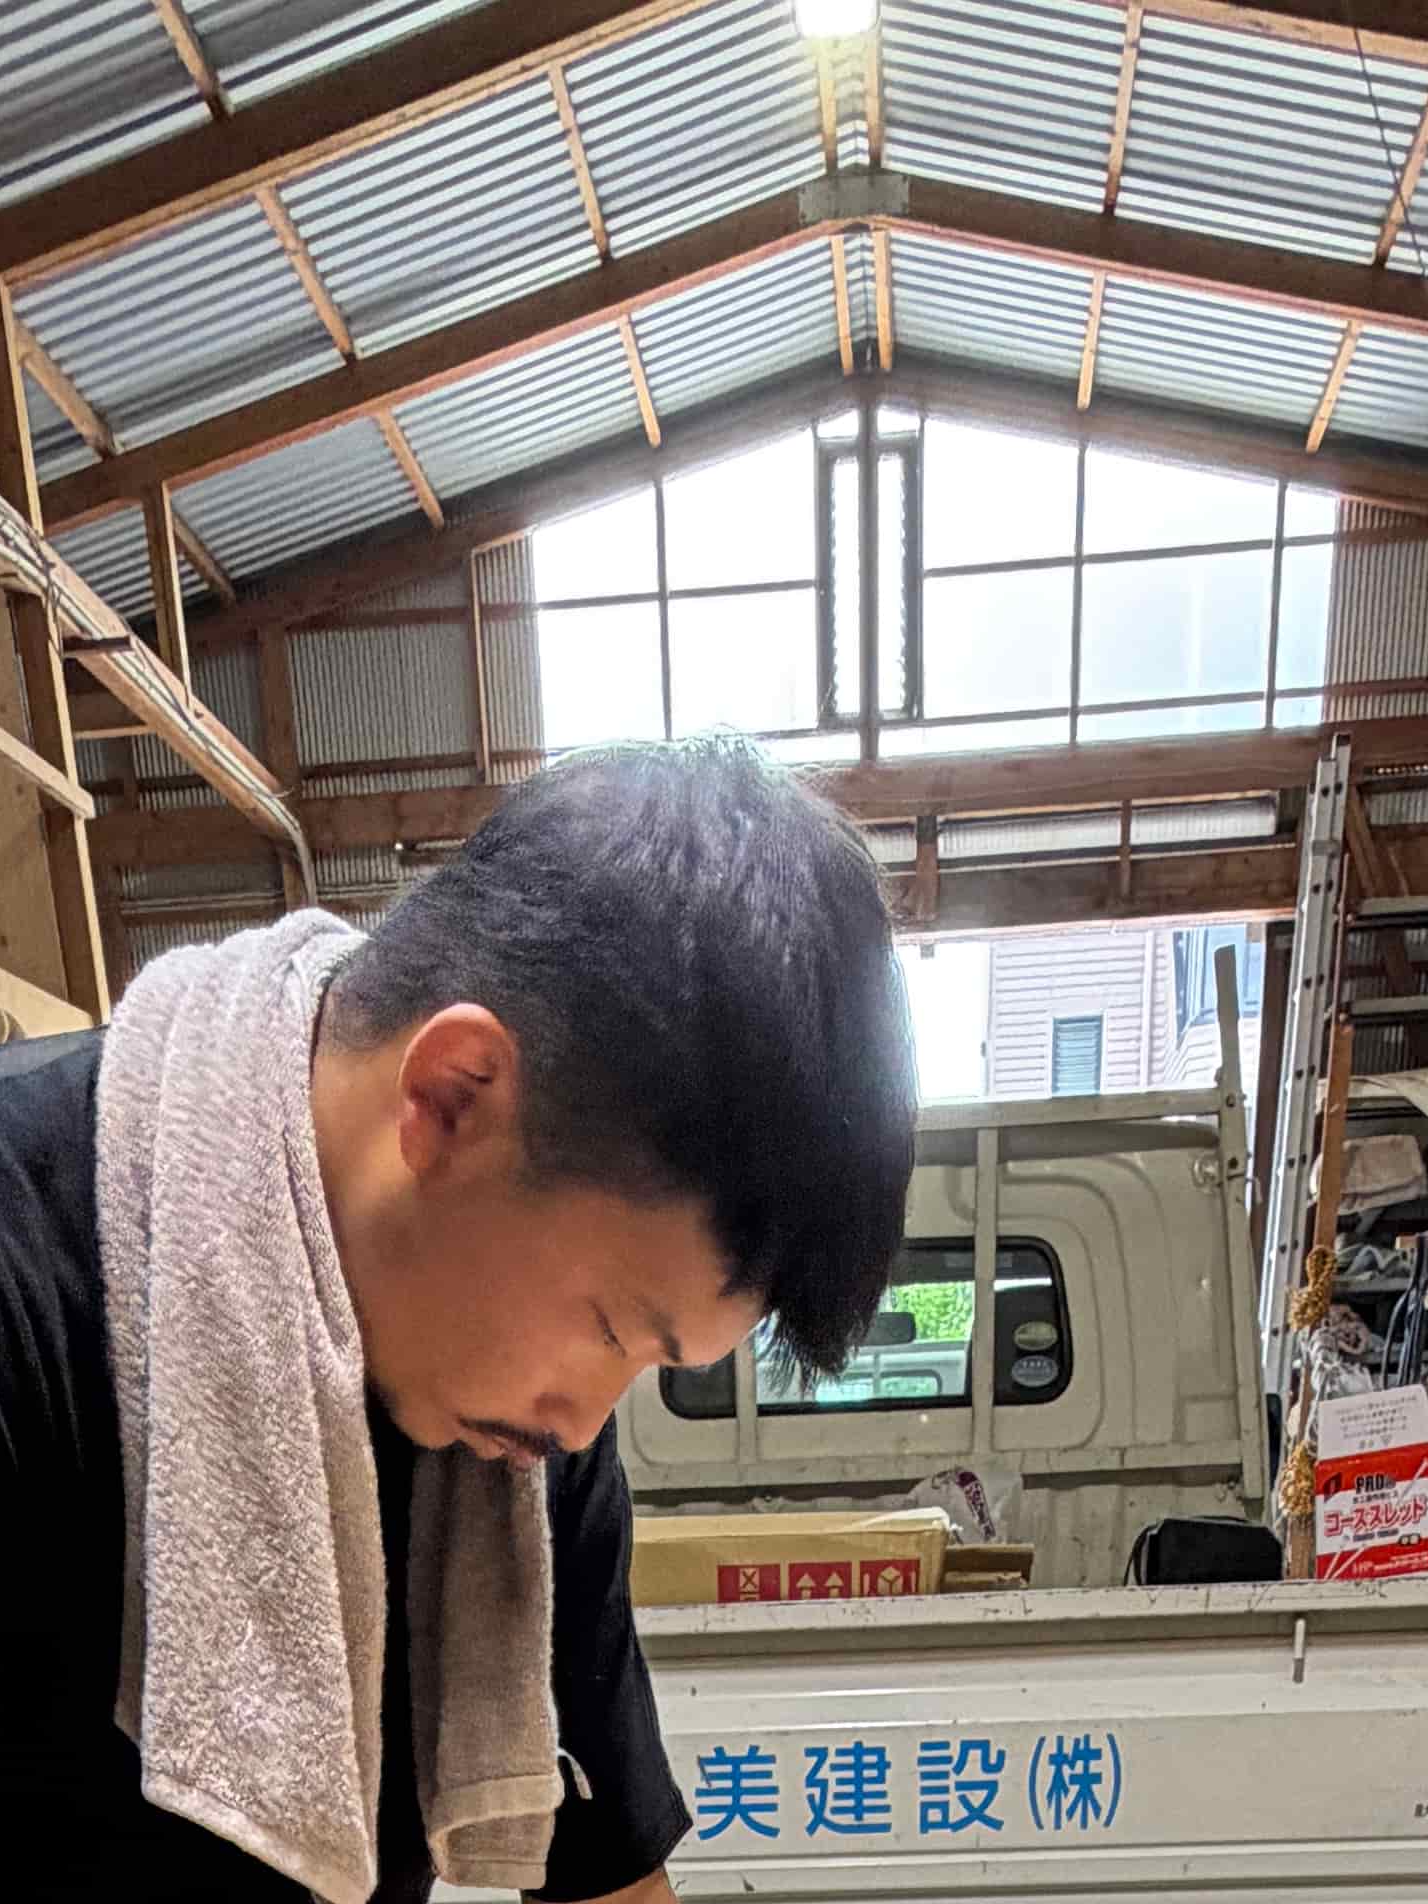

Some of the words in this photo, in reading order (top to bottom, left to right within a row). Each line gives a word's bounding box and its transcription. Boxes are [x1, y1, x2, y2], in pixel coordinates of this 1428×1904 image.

[1323, 1495, 1428, 1538] コーススレッド
